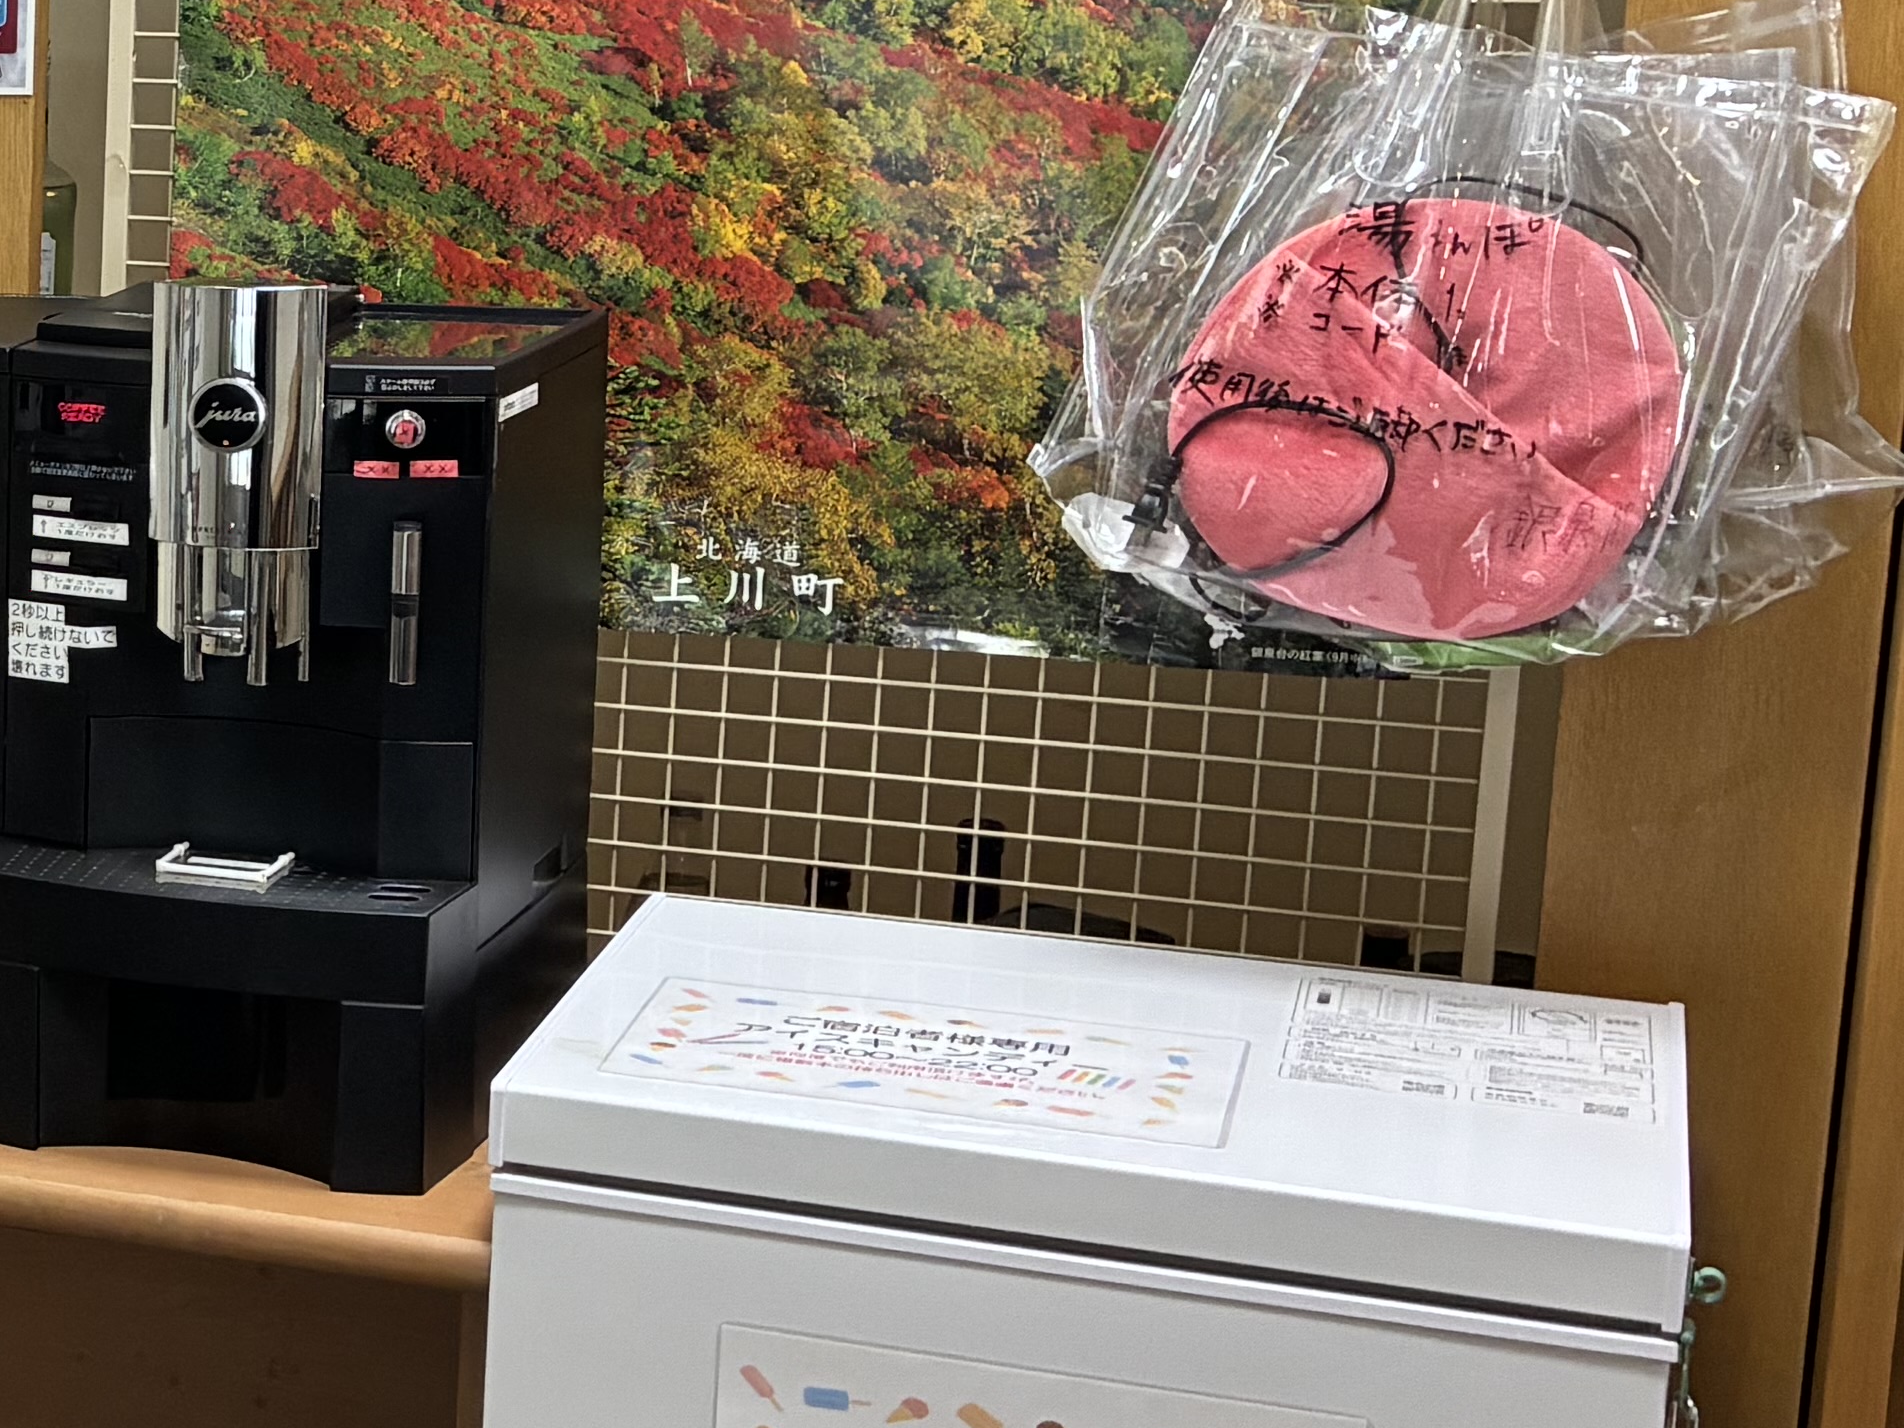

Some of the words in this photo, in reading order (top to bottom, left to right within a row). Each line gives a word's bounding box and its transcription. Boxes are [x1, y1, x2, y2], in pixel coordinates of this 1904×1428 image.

[194, 402, 256, 428] jura
[696, 536, 801, 567] 北海道
[653, 562, 844, 615] 上川町
[11, 603, 64, 622] 2秒以上
[11, 622, 116, 645] 押し続けないで
[11, 644, 68, 659] ください
[783, 1015, 1071, 1057] ご宿泊者様専用
